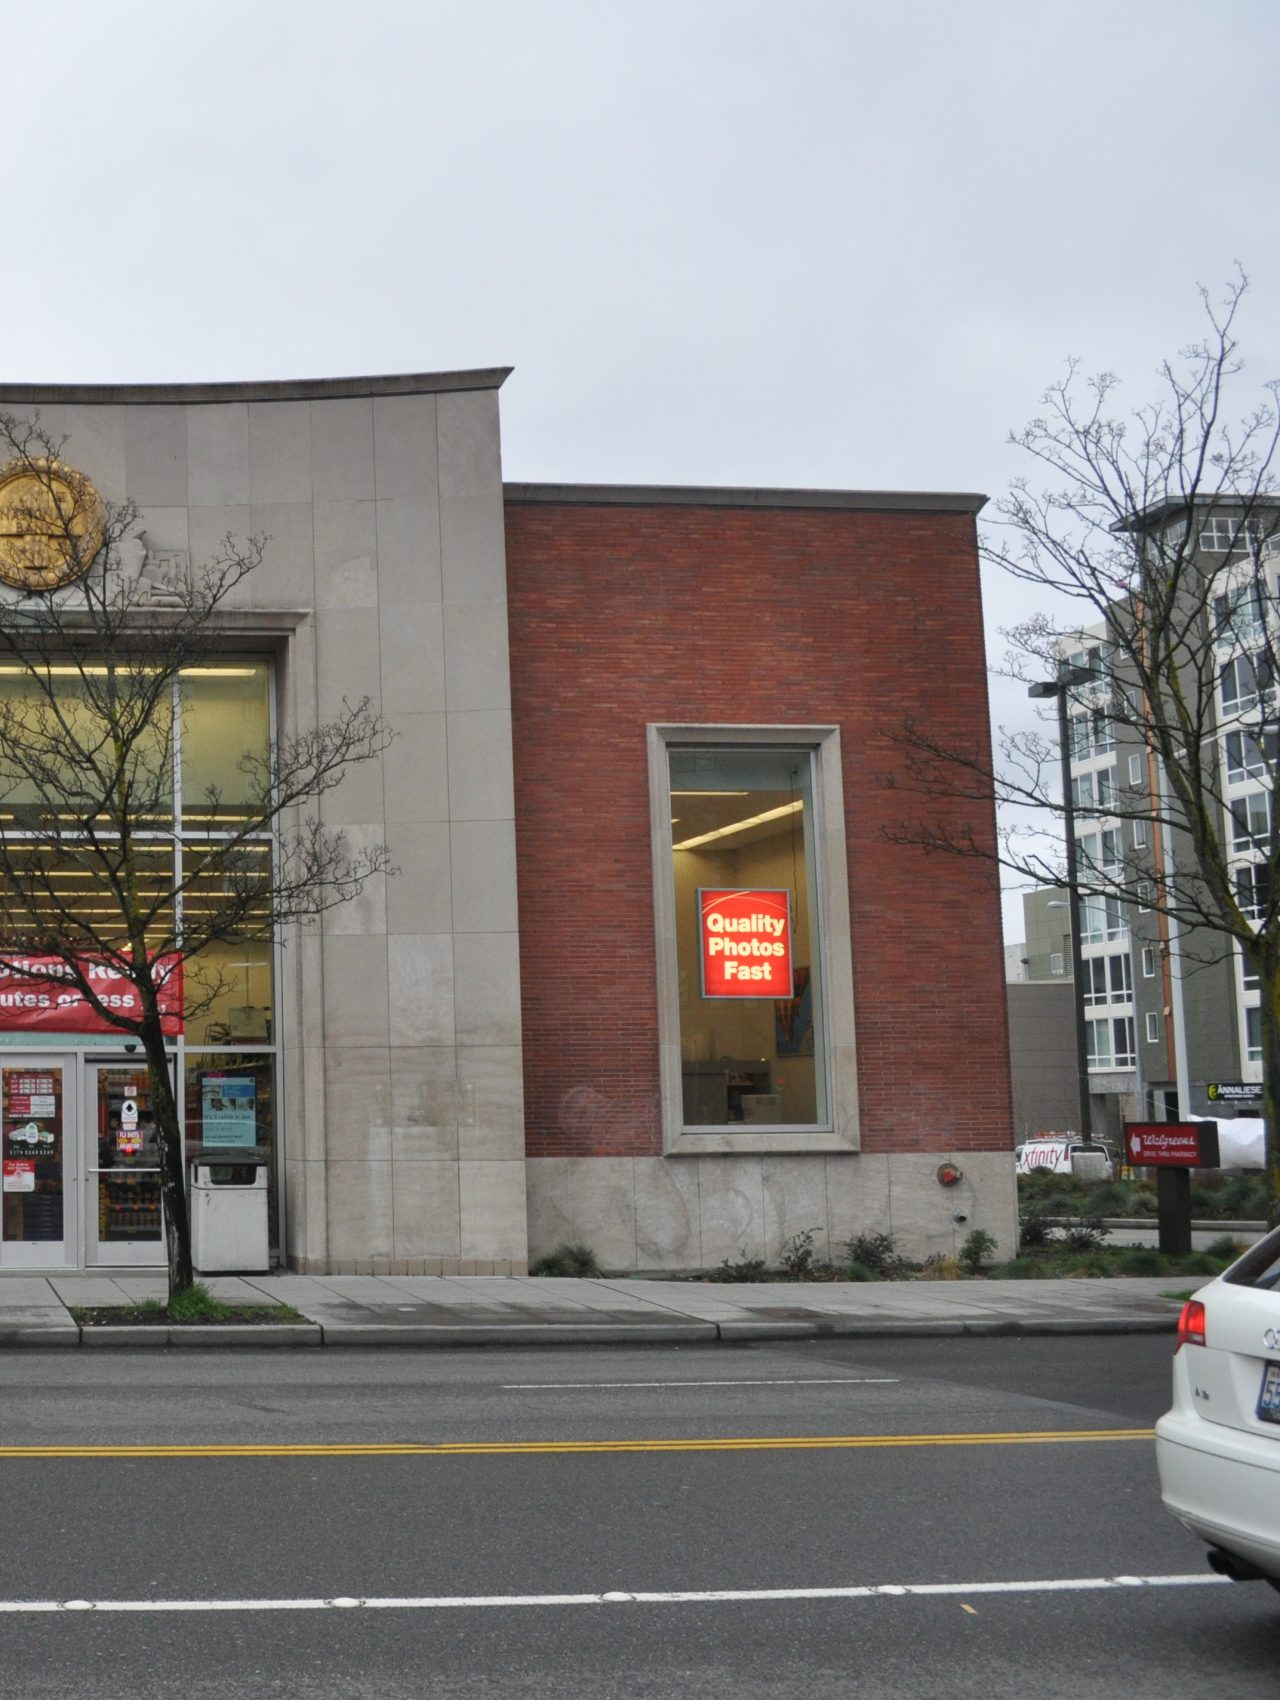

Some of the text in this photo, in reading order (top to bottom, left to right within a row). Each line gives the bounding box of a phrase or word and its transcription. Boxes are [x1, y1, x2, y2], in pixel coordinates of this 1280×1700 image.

[706, 913, 785, 937] Quality
[708, 937, 785, 957] Photos
[724, 961, 772, 980] Fast
[57, 992, 83, 1008] or
[87, 990, 135, 1008] ess
[1142, 1134, 1195, 1150] Walgreens
[1024, 1146, 1063, 1171] xfinity
